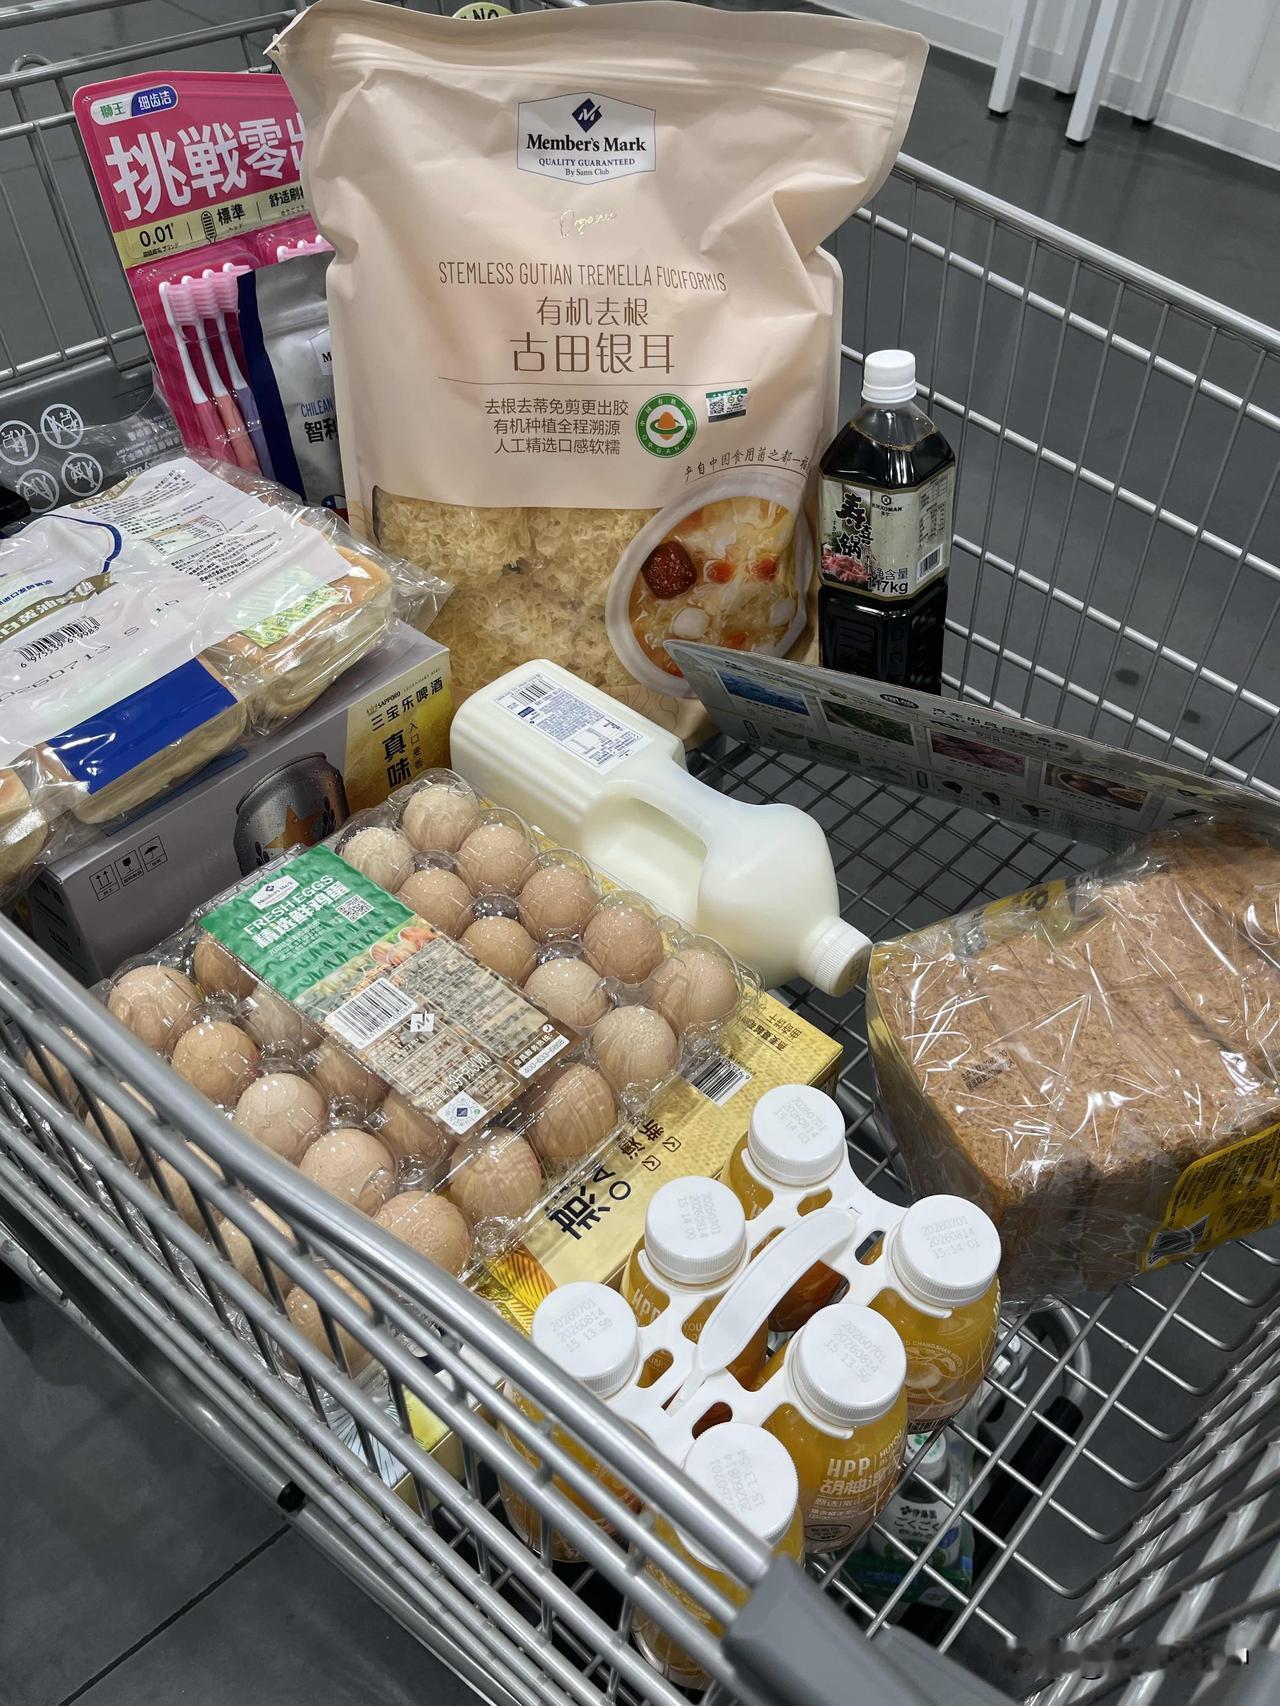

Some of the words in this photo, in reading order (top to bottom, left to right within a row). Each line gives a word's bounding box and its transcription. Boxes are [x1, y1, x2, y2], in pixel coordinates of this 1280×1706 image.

[138, 91, 172, 111] 细齿洁
[527, 134, 600, 152] Member's
[604, 136, 647, 152] Mark
[539, 158, 576, 167] QUALITY
[578, 158, 636, 167] GUARANTEED
[565, 168, 575, 176] By
[594, 168, 610, 176] Club
[217, 203, 246, 226] 標準
[438, 262, 514, 285] STEMLESS
[519, 263, 572, 286] GUTIAN
[577, 264, 652, 287] TREMELLA
[656, 266, 727, 292] FUCIFORMIS
[536, 296, 649, 326] 有机去根
[509, 331, 675, 374] 古田银耳
[485, 398, 629, 416] 去根去蒂免剪更出胶
[493, 418, 621, 436] 有机种植全程溯源
[494, 437, 621, 455] 人工精选口感软糯
[371, 676, 444, 732] 三宝乐啤酒
[377, 690, 401, 709] SAPPORO
[382, 729, 412, 789] 真味
[244, 903, 296, 936] FRESH
[295, 875, 335, 906] EGGS
[252, 880, 351, 948] 精选鲜鸡蛋
[765, 1012, 803, 1040] 曲奇饼干
[827, 1456, 871, 1478] HPP
